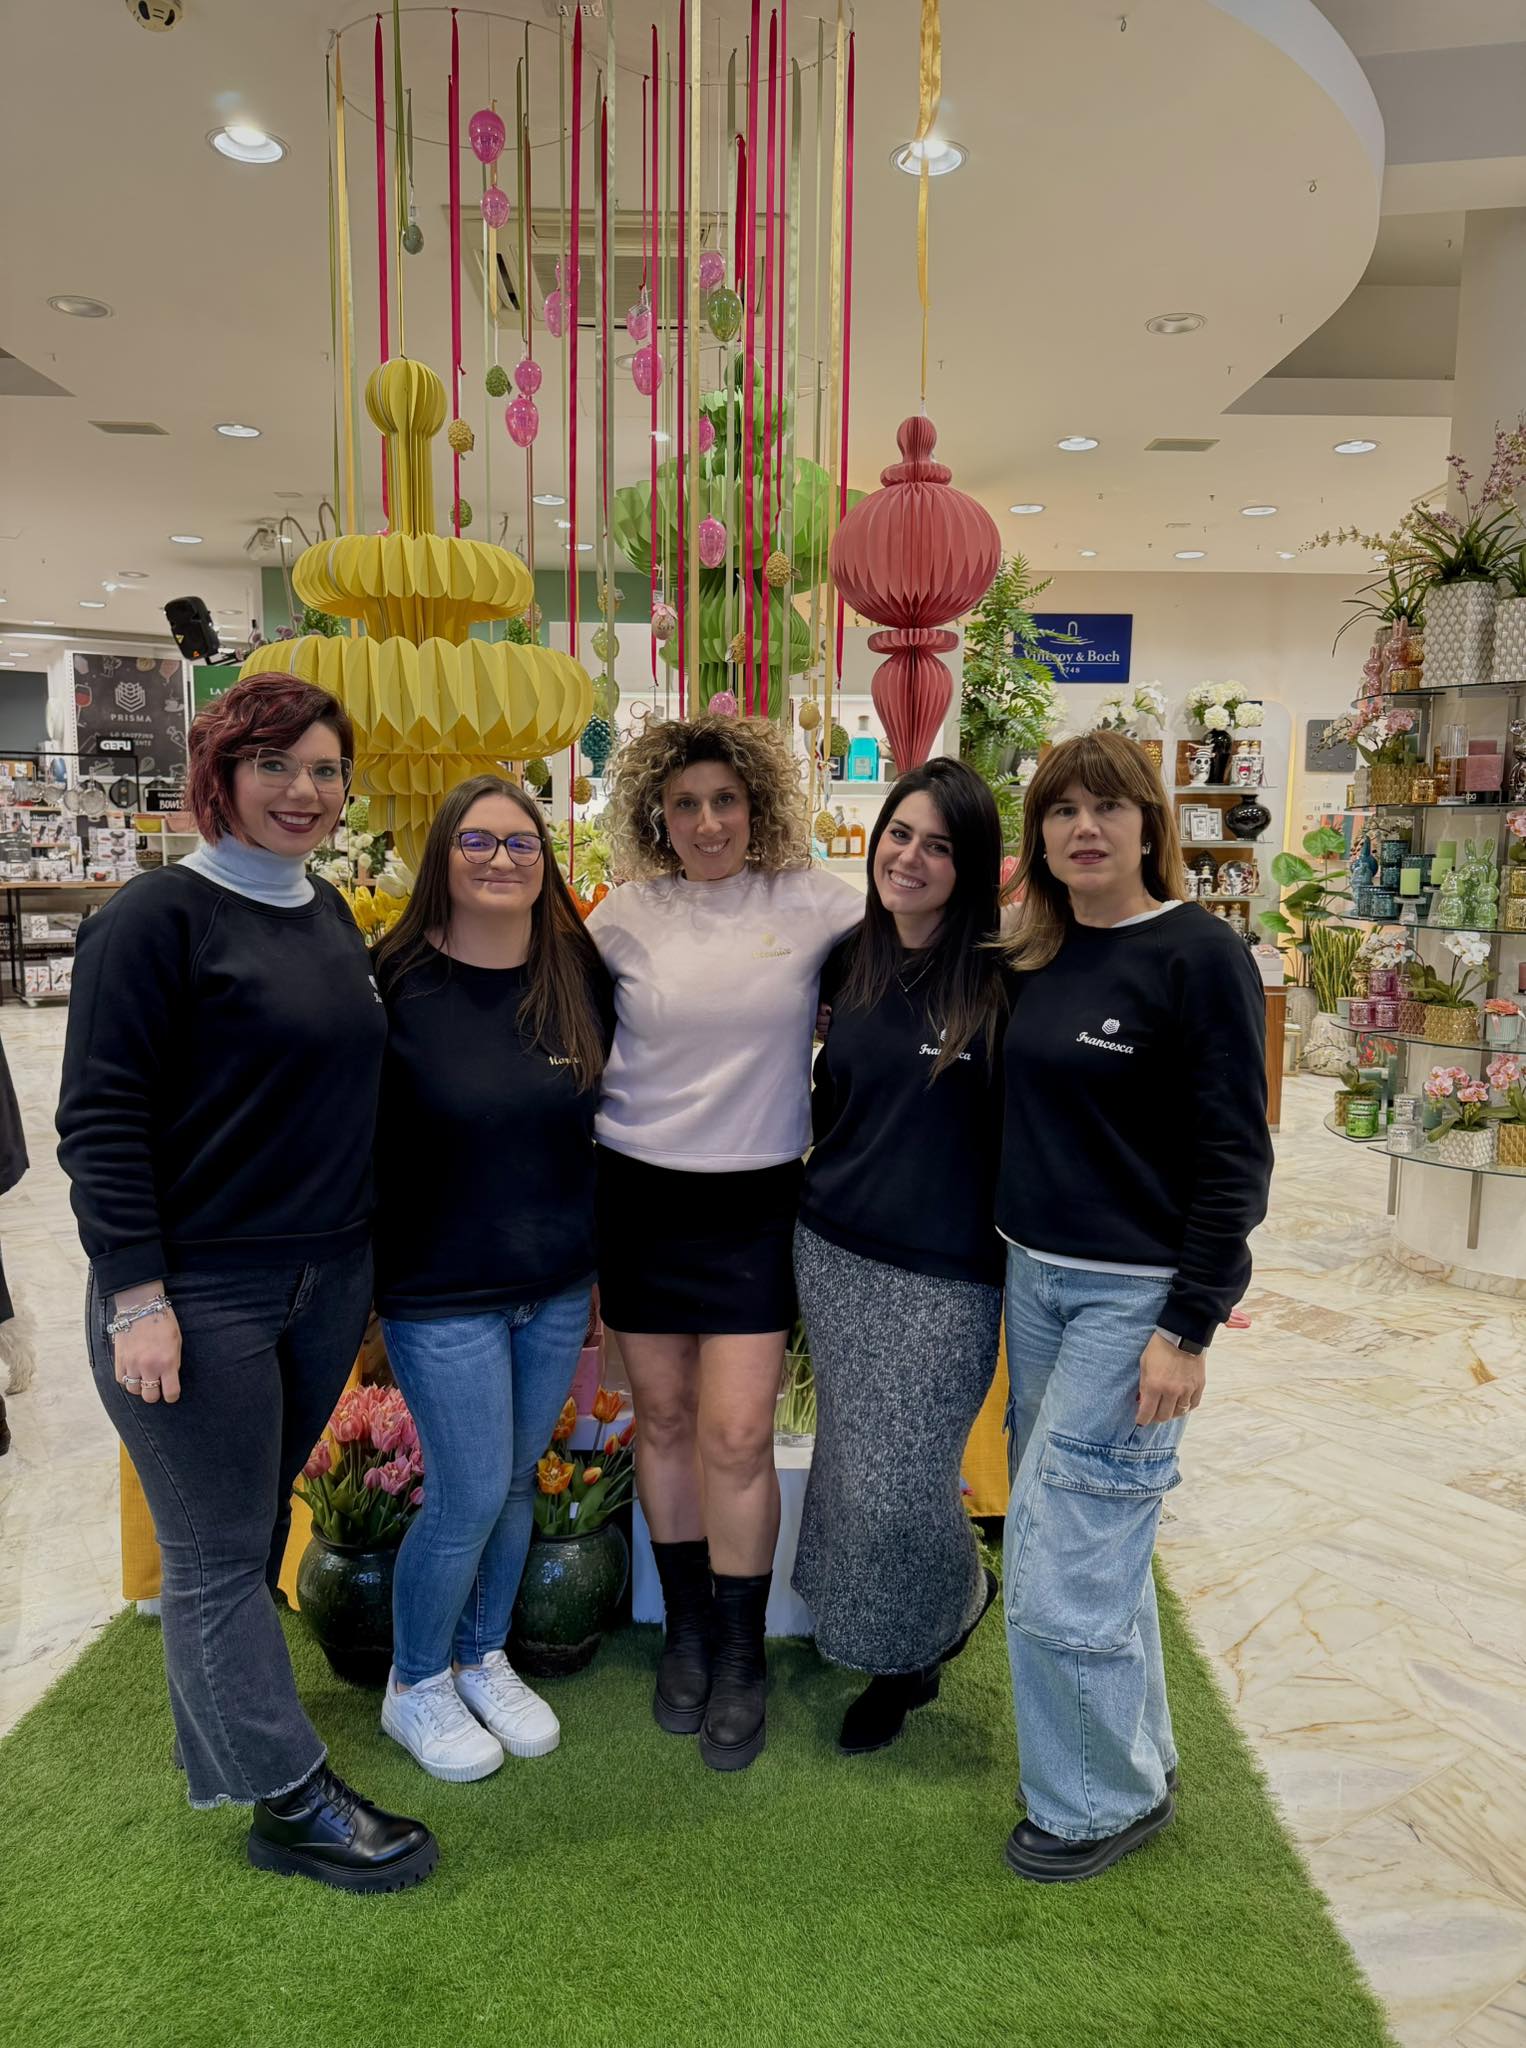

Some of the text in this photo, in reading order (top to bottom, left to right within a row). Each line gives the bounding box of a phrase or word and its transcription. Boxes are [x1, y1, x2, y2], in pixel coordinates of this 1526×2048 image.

[1076, 652, 1085, 662] &
[1087, 650, 1120, 662] Boch
[110, 713, 152, 722] PRISMA
[100, 740, 132, 751] GEFU
[159, 799, 185, 810] BOWLS
[1076, 1031, 1134, 1054] Francesca
